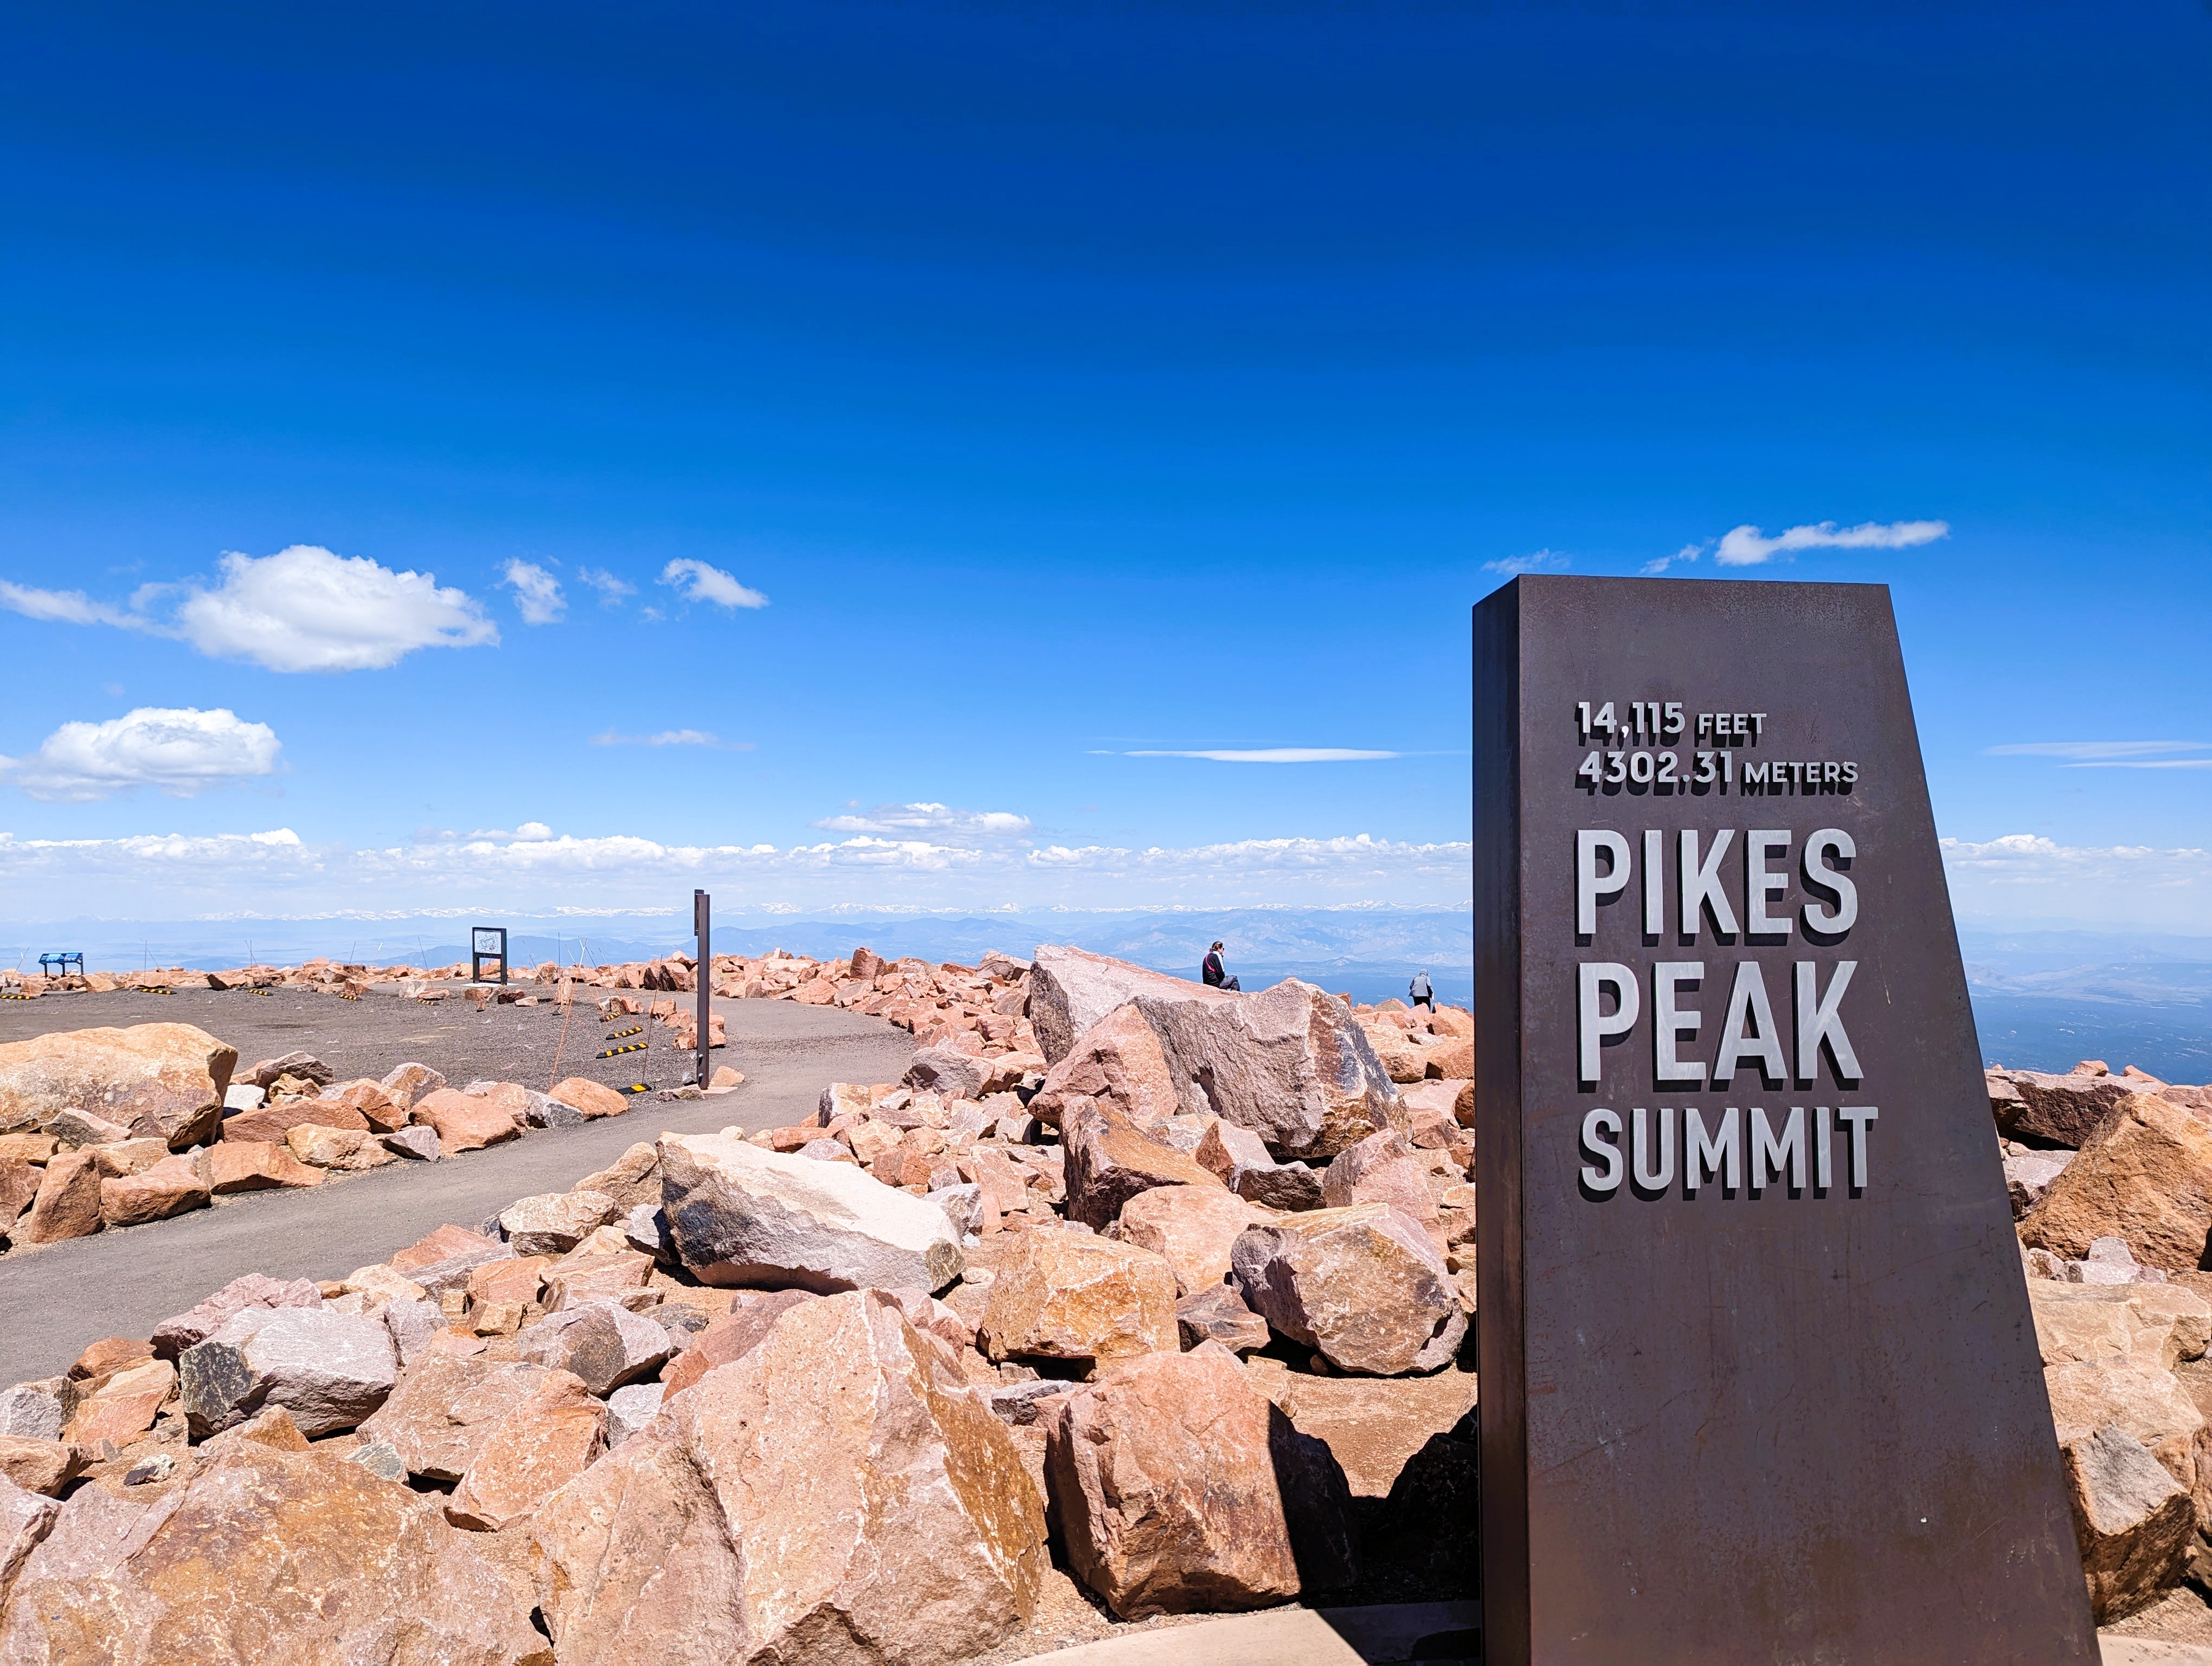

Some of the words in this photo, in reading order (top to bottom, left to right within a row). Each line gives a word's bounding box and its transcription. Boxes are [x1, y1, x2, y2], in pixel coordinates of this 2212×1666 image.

[1578, 702, 1685, 738] 14,115
[1699, 713, 1767, 734] FEET
[1578, 751, 1733, 783] 4302.31
[1745, 761, 1859, 783] METERS
[1577, 829, 1858, 934] PIKES
[1579, 961, 1864, 1081] PEAK
[1580, 1107, 1879, 1191] SUMMIT
